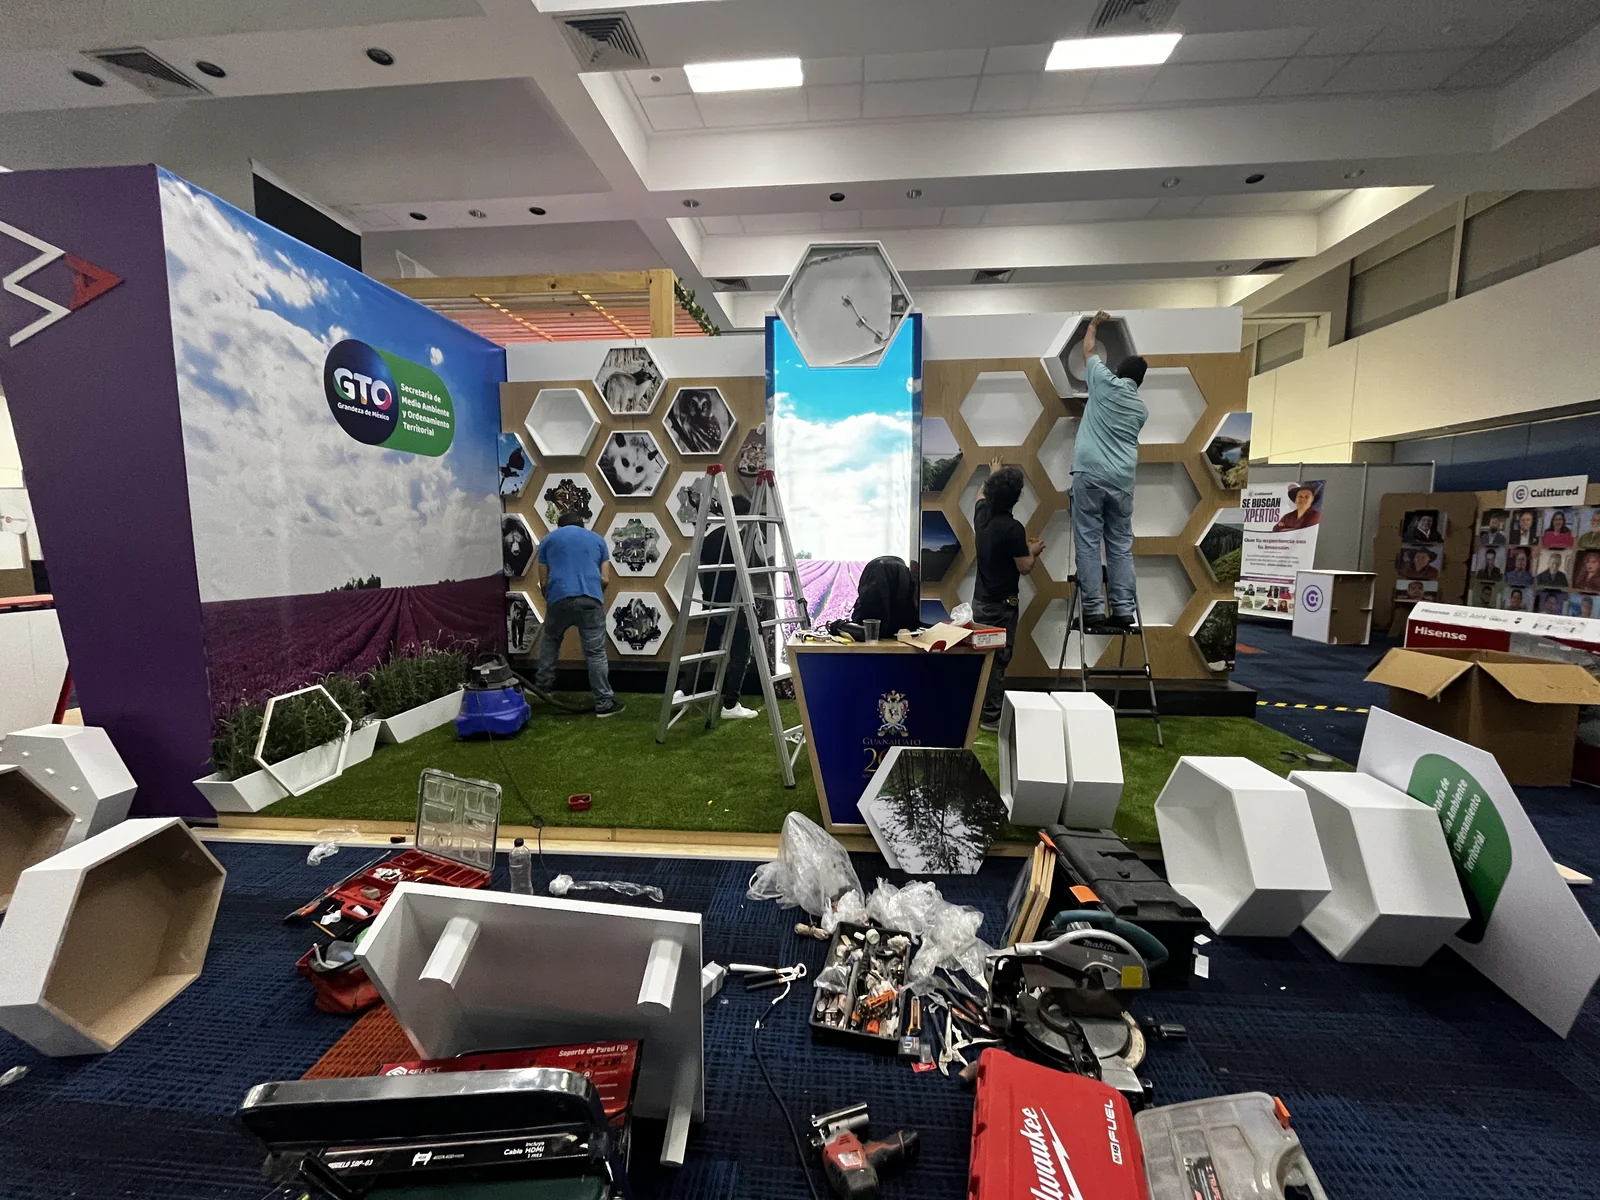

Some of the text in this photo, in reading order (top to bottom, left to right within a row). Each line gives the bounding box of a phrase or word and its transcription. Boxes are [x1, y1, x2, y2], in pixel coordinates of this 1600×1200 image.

[333, 367, 392, 410] GTO
[401, 396, 450, 418] Medio Ambiente
[434, 395, 442, 403] de
[337, 402, 390, 421] Grandeza de México
[402, 410, 450, 429] y Ordenamiento
[403, 421, 435, 437] Territorial
[1530, 486, 1580, 498] Culttured
[1242, 497, 1281, 509] SE BUSCAN
[1414, 625, 1467, 641] Hisense
[1447, 779, 1468, 822] Ambiente
[1453, 793, 1482, 853] Ordenamiento
[1464, 829, 1486, 873] Territorial
[559, 1049, 584, 1057] Soporte
[596, 1045, 615, 1053] Pared
[1104, 1099, 1121, 1164] M18 FUEL
[503, 1146, 545, 1156] Cable HDMI
[1020, 1107, 1064, 1200] lwaukee
